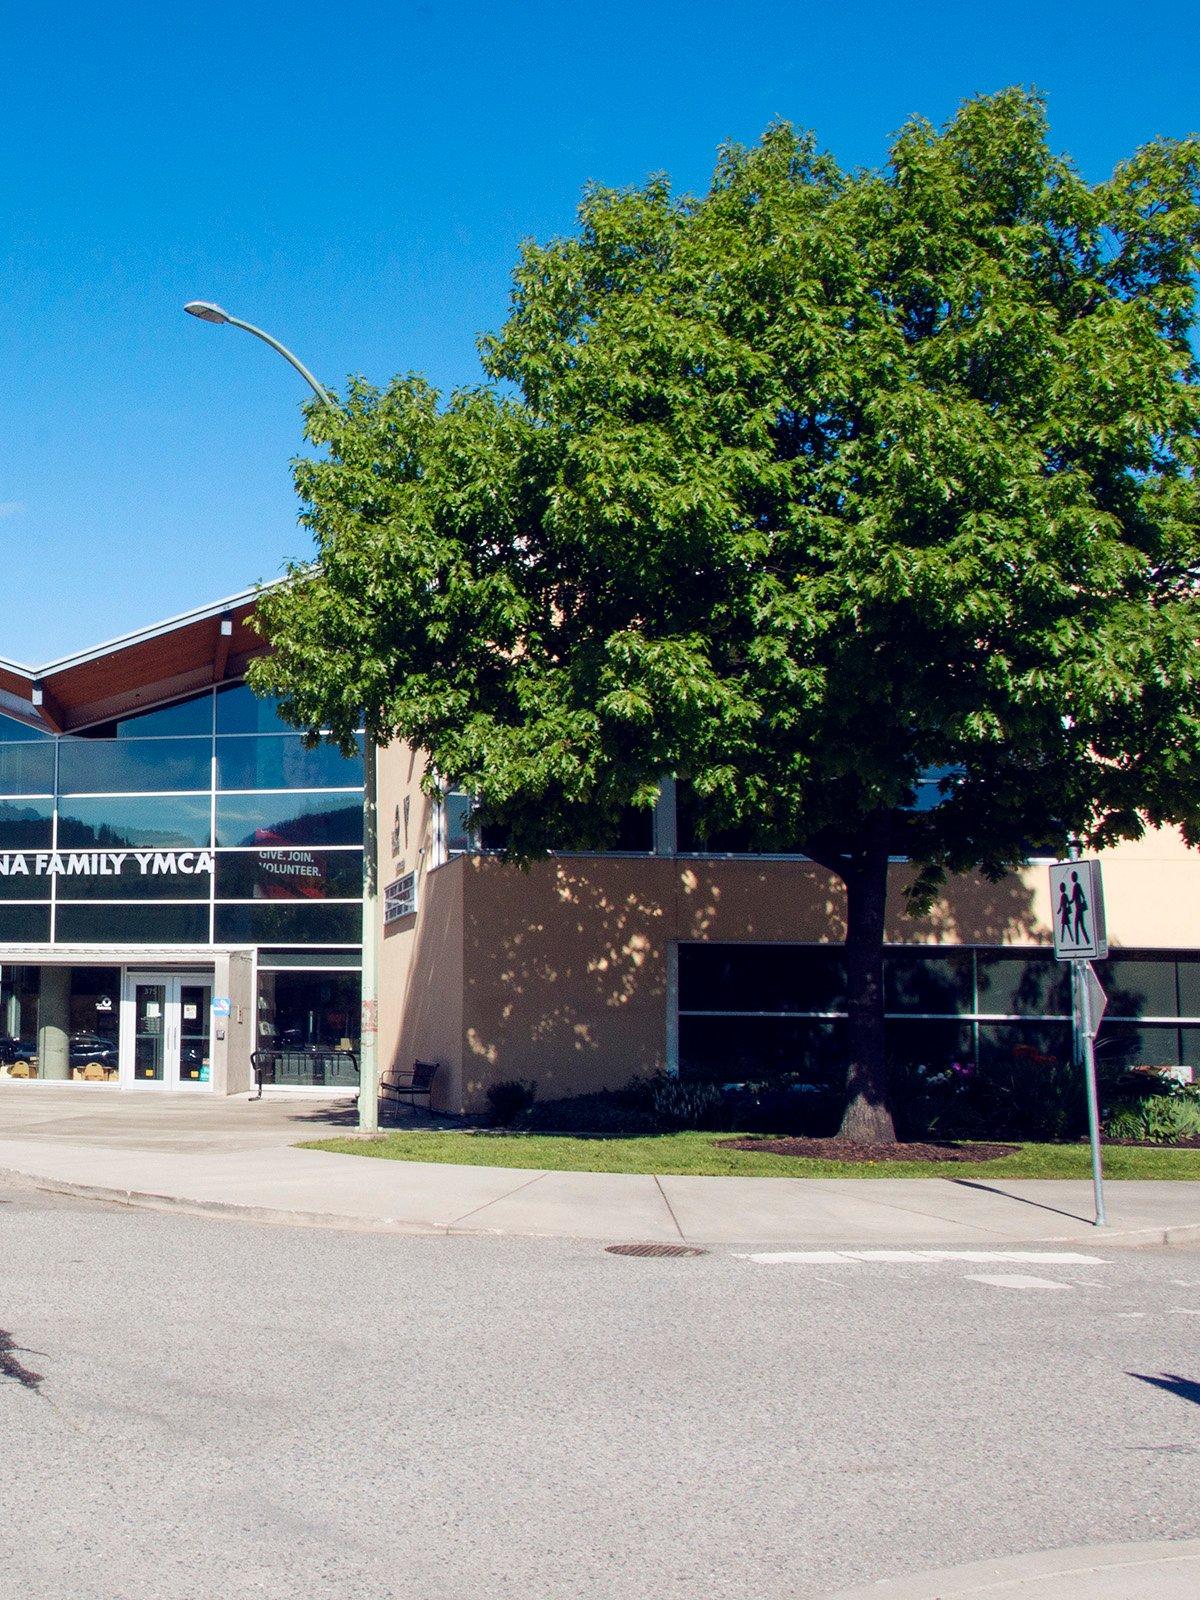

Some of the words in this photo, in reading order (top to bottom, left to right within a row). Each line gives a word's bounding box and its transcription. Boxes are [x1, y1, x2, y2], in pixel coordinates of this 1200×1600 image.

[35, 853, 127, 876] FAMILY
[134, 852, 215, 875] YMCA
[259, 850, 286, 861] GIVE.
[287, 851, 314, 863] JOIN.
